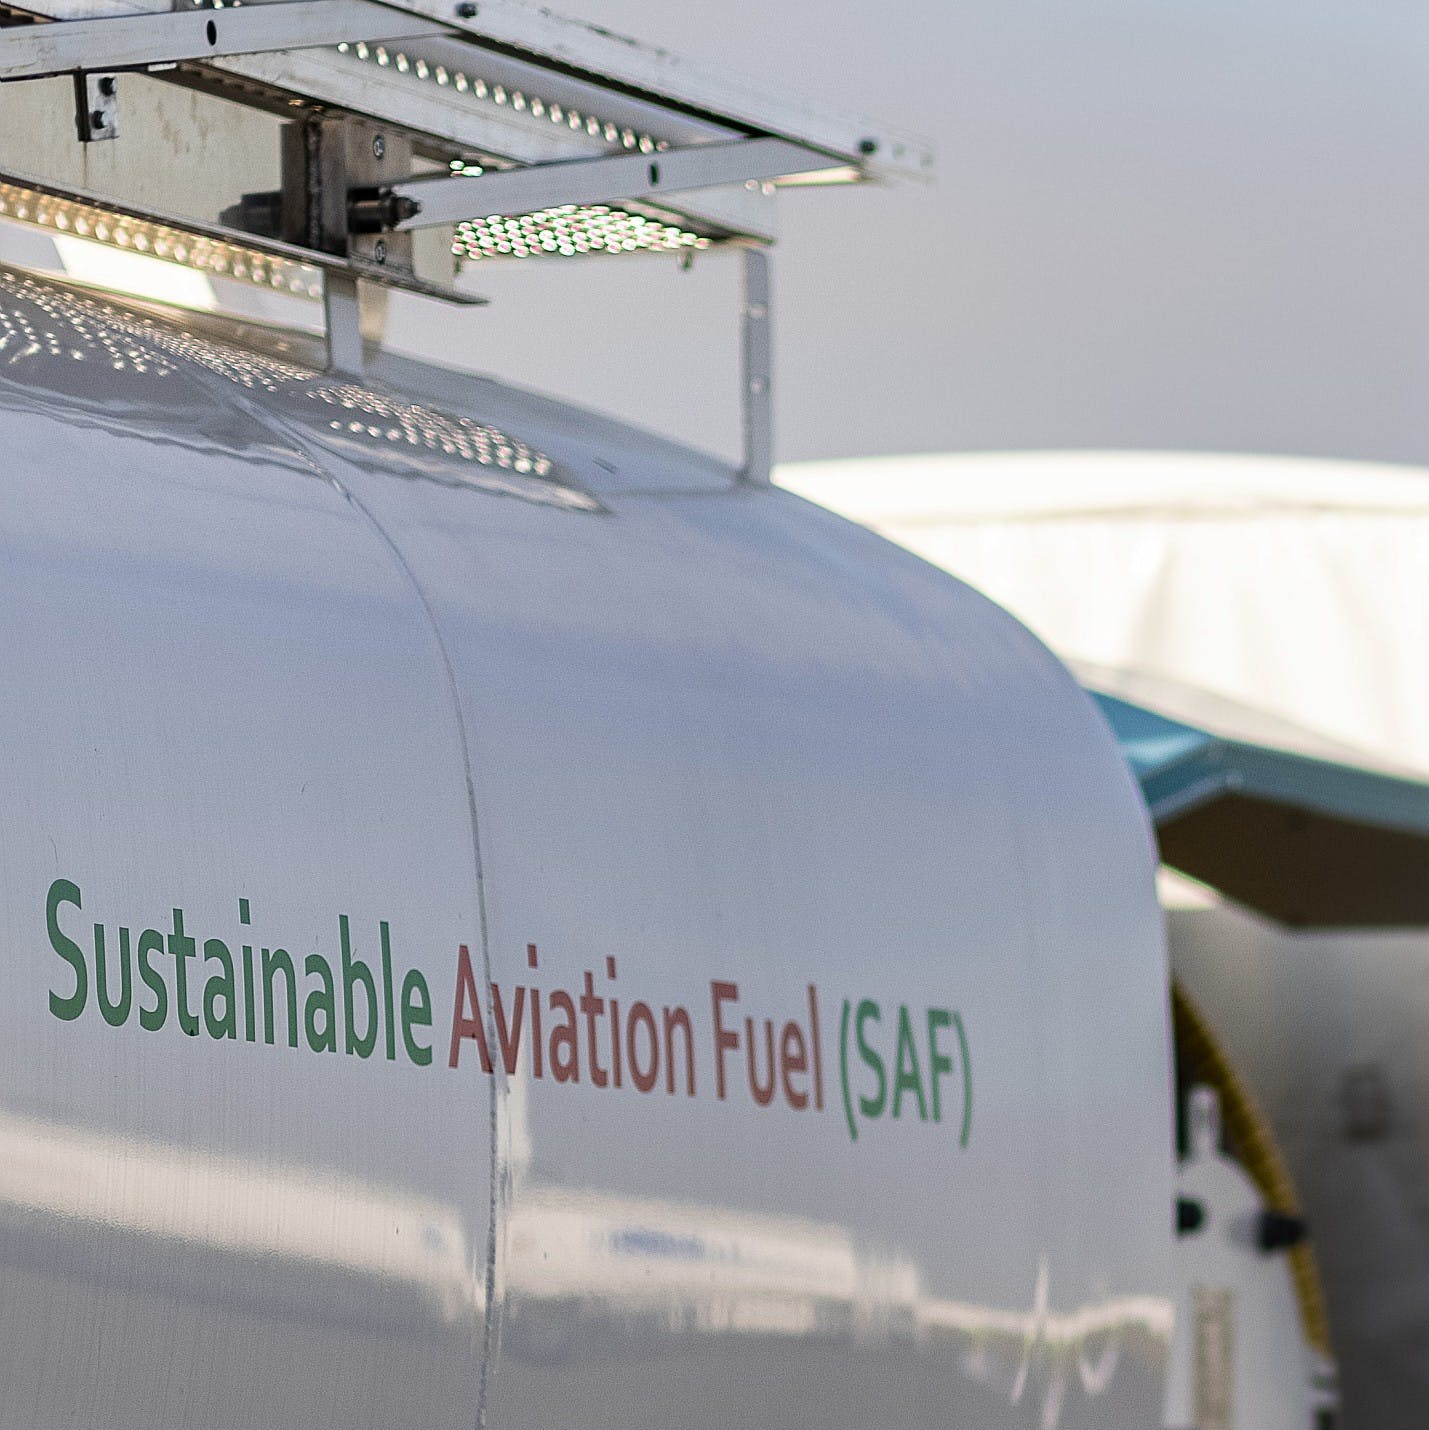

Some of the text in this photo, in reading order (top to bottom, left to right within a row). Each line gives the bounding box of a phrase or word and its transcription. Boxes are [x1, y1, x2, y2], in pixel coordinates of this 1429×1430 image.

[46, 879, 974, 1149] Sustainable Aviation Fuel (SAF)
